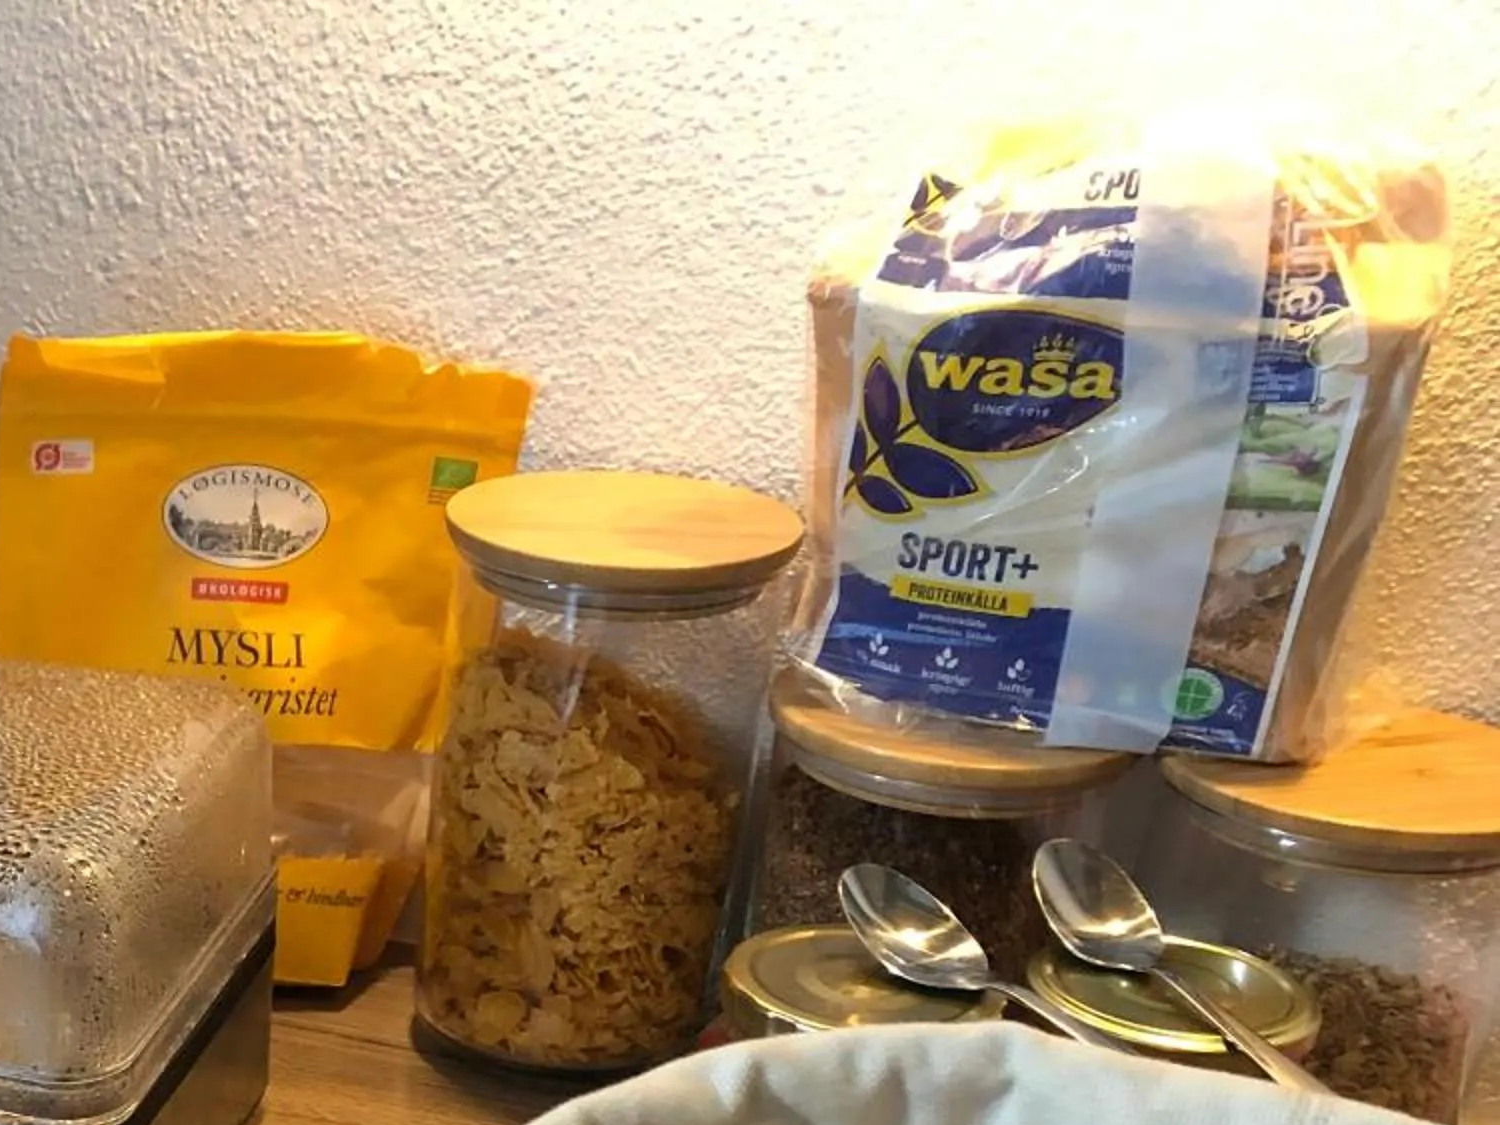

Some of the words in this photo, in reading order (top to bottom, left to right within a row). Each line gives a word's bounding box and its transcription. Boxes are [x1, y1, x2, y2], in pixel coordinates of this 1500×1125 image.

[1084, 168, 1140, 202] SPO
[919, 351, 1117, 400] wasa
[971, 403, 1015, 417] SINCE
[897, 532, 1040, 583] SPORT+
[198, 582, 282, 600] ØKOLOGISK
[167, 627, 307, 669] MYSLI
